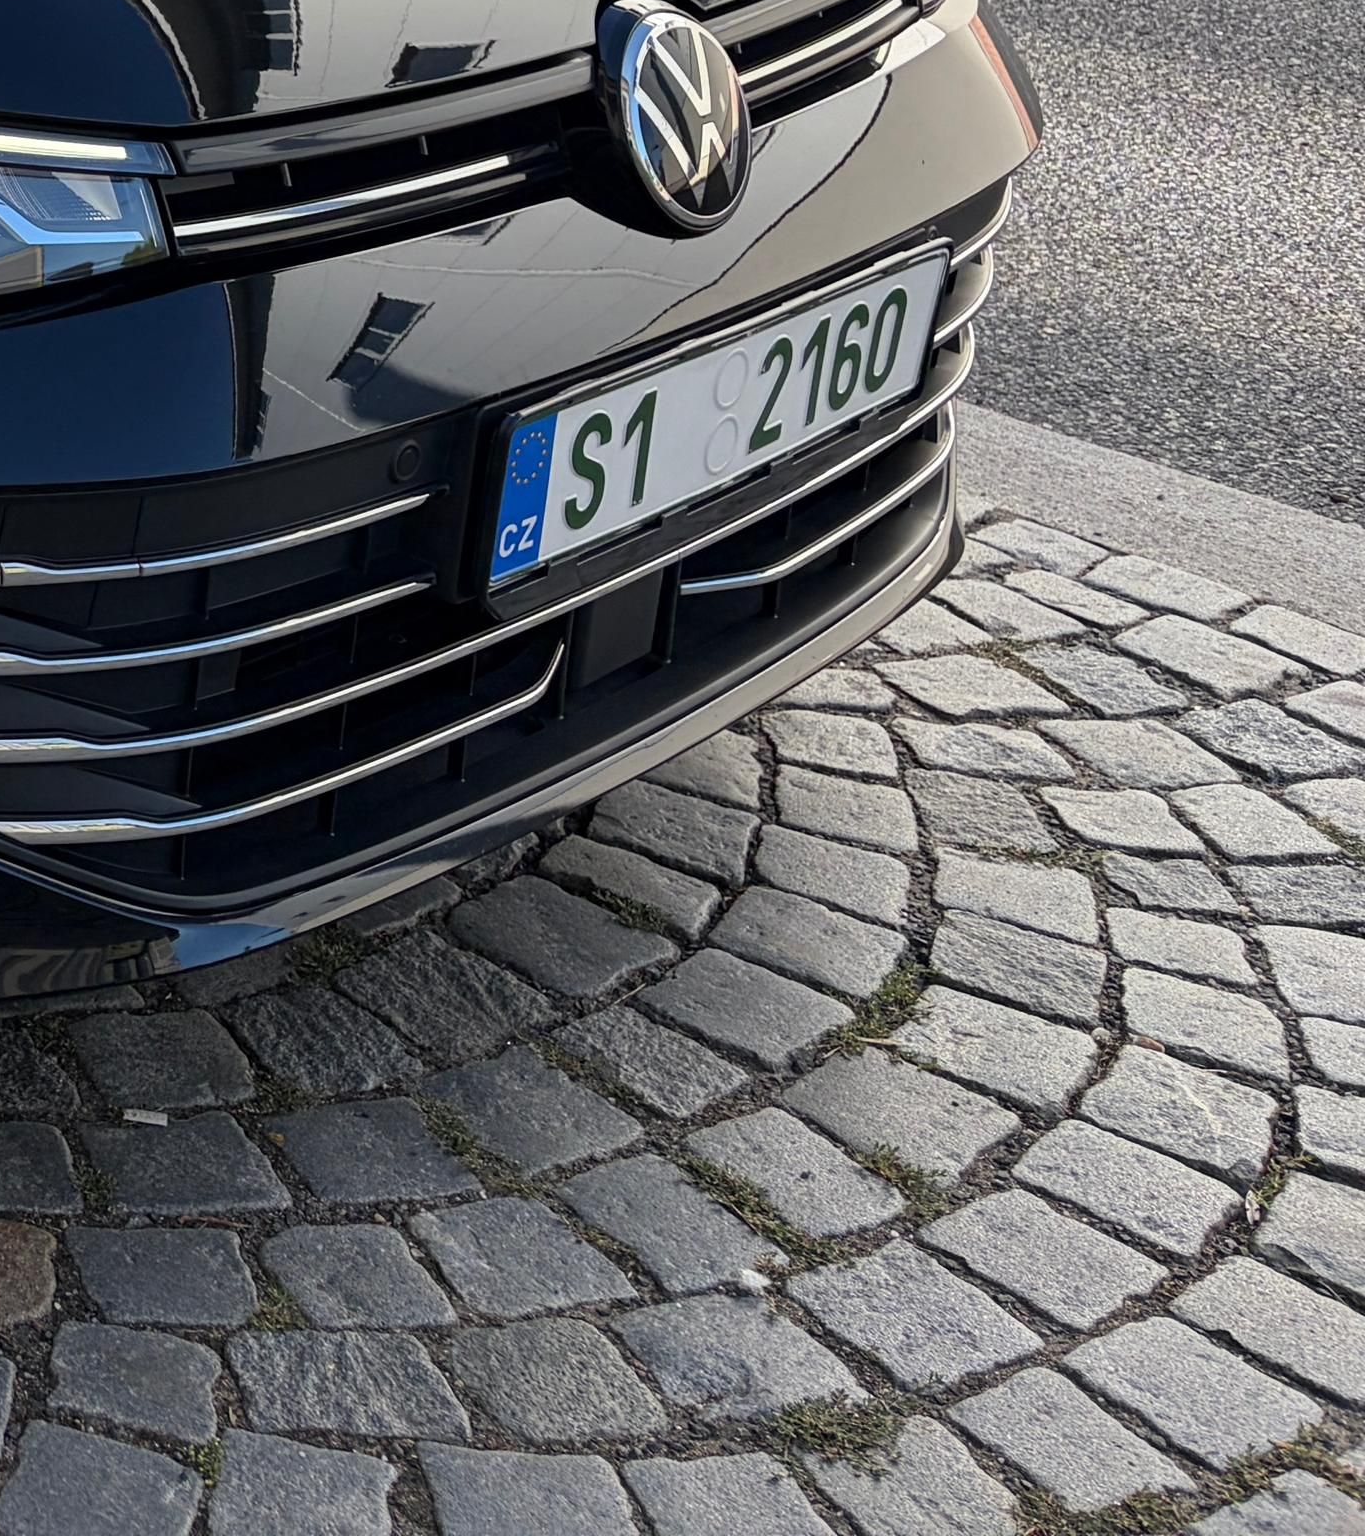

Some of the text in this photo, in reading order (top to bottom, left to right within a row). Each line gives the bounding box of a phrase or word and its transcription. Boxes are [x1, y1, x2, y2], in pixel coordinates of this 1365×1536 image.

[565, 287, 908, 530] S1 2160
[498, 514, 537, 559] CZ
